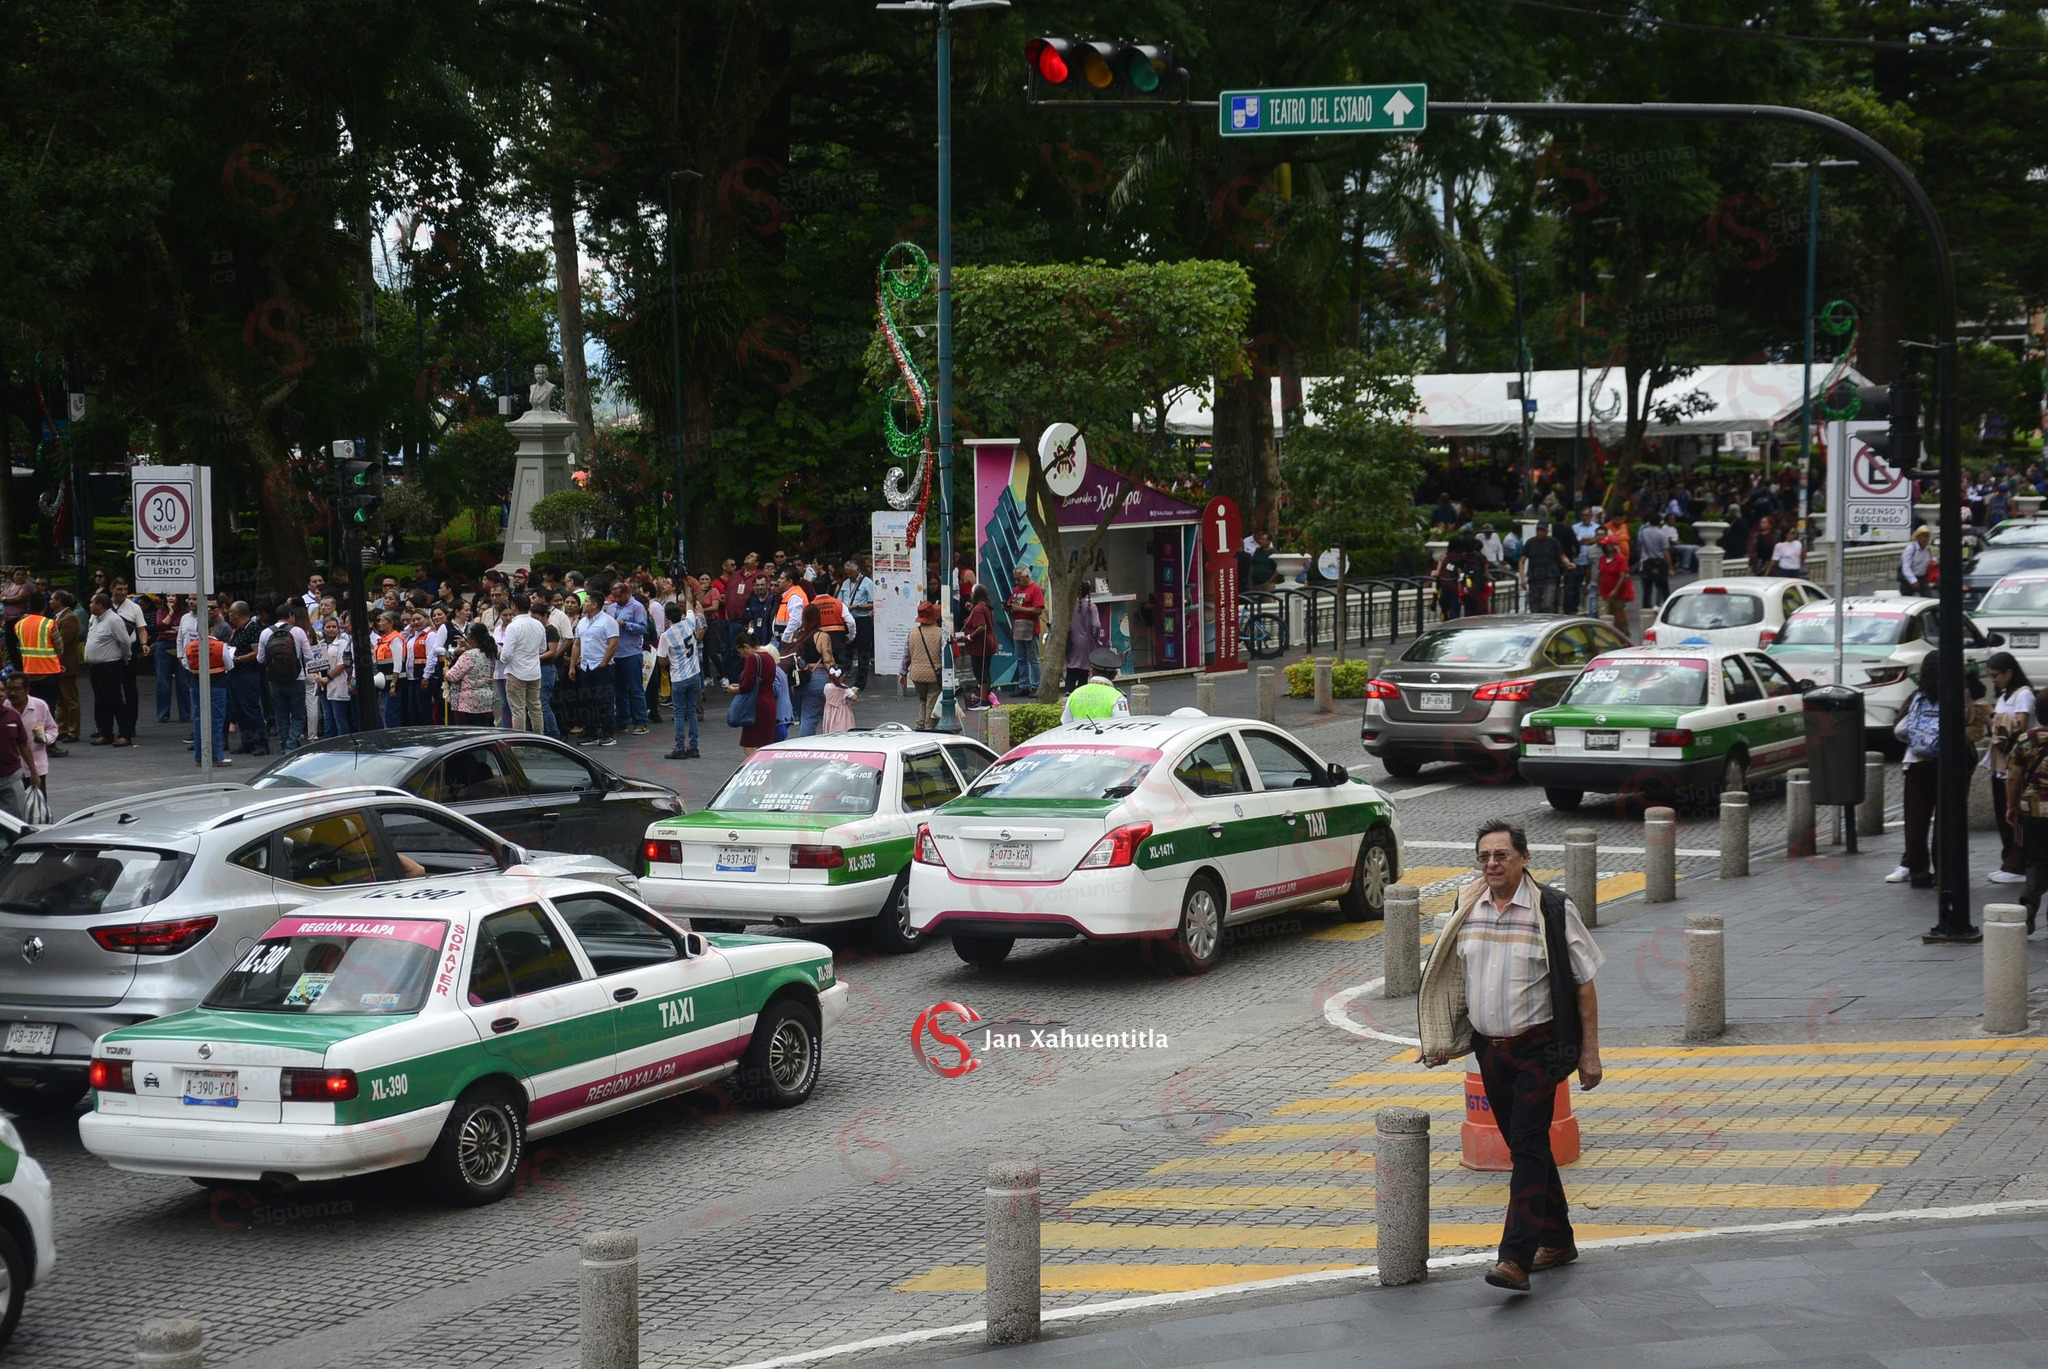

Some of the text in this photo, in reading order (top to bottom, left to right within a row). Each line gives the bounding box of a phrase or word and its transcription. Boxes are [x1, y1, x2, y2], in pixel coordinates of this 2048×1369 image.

[1269, 95, 1373, 125] TEATRO DEL ESTADO
[153, 497, 176, 522] 30
[1854, 507, 1905, 515] ASCENSO Y
[1853, 515, 1901, 523] DESCENSO
[153, 524, 176, 532] KM/H
[145, 556, 188, 567] TRÁNSITO
[153, 567, 181, 575] LENTO
[683, 635, 694, 659] 5
[810, 752, 849, 761] XALAPA
[1076, 748, 1116, 757] XALAPA
[988, 760, 1041, 775] XL-1471
[1304, 811, 1328, 838] TAXI
[990, 849, 1030, 860] A-073-XGR
[1149, 842, 1174, 859] XL-1471
[717, 853, 756, 866] A-937-XCU
[848, 852, 876, 872] XL-3635
[1276, 882, 1297, 895] XALAPA
[297, 920, 396, 936] REGIÓN XALAPA
[234, 944, 292, 974] XL-390
[436, 924, 465, 996] SOPAVER
[816, 963, 834, 982] XL-390
[658, 996, 695, 1029] TAXI
[186, 1080, 235, 1097] A-390-XCA
[371, 1073, 408, 1101] XL-390
[585, 1062, 677, 1103] REGIÓN XALAPA
